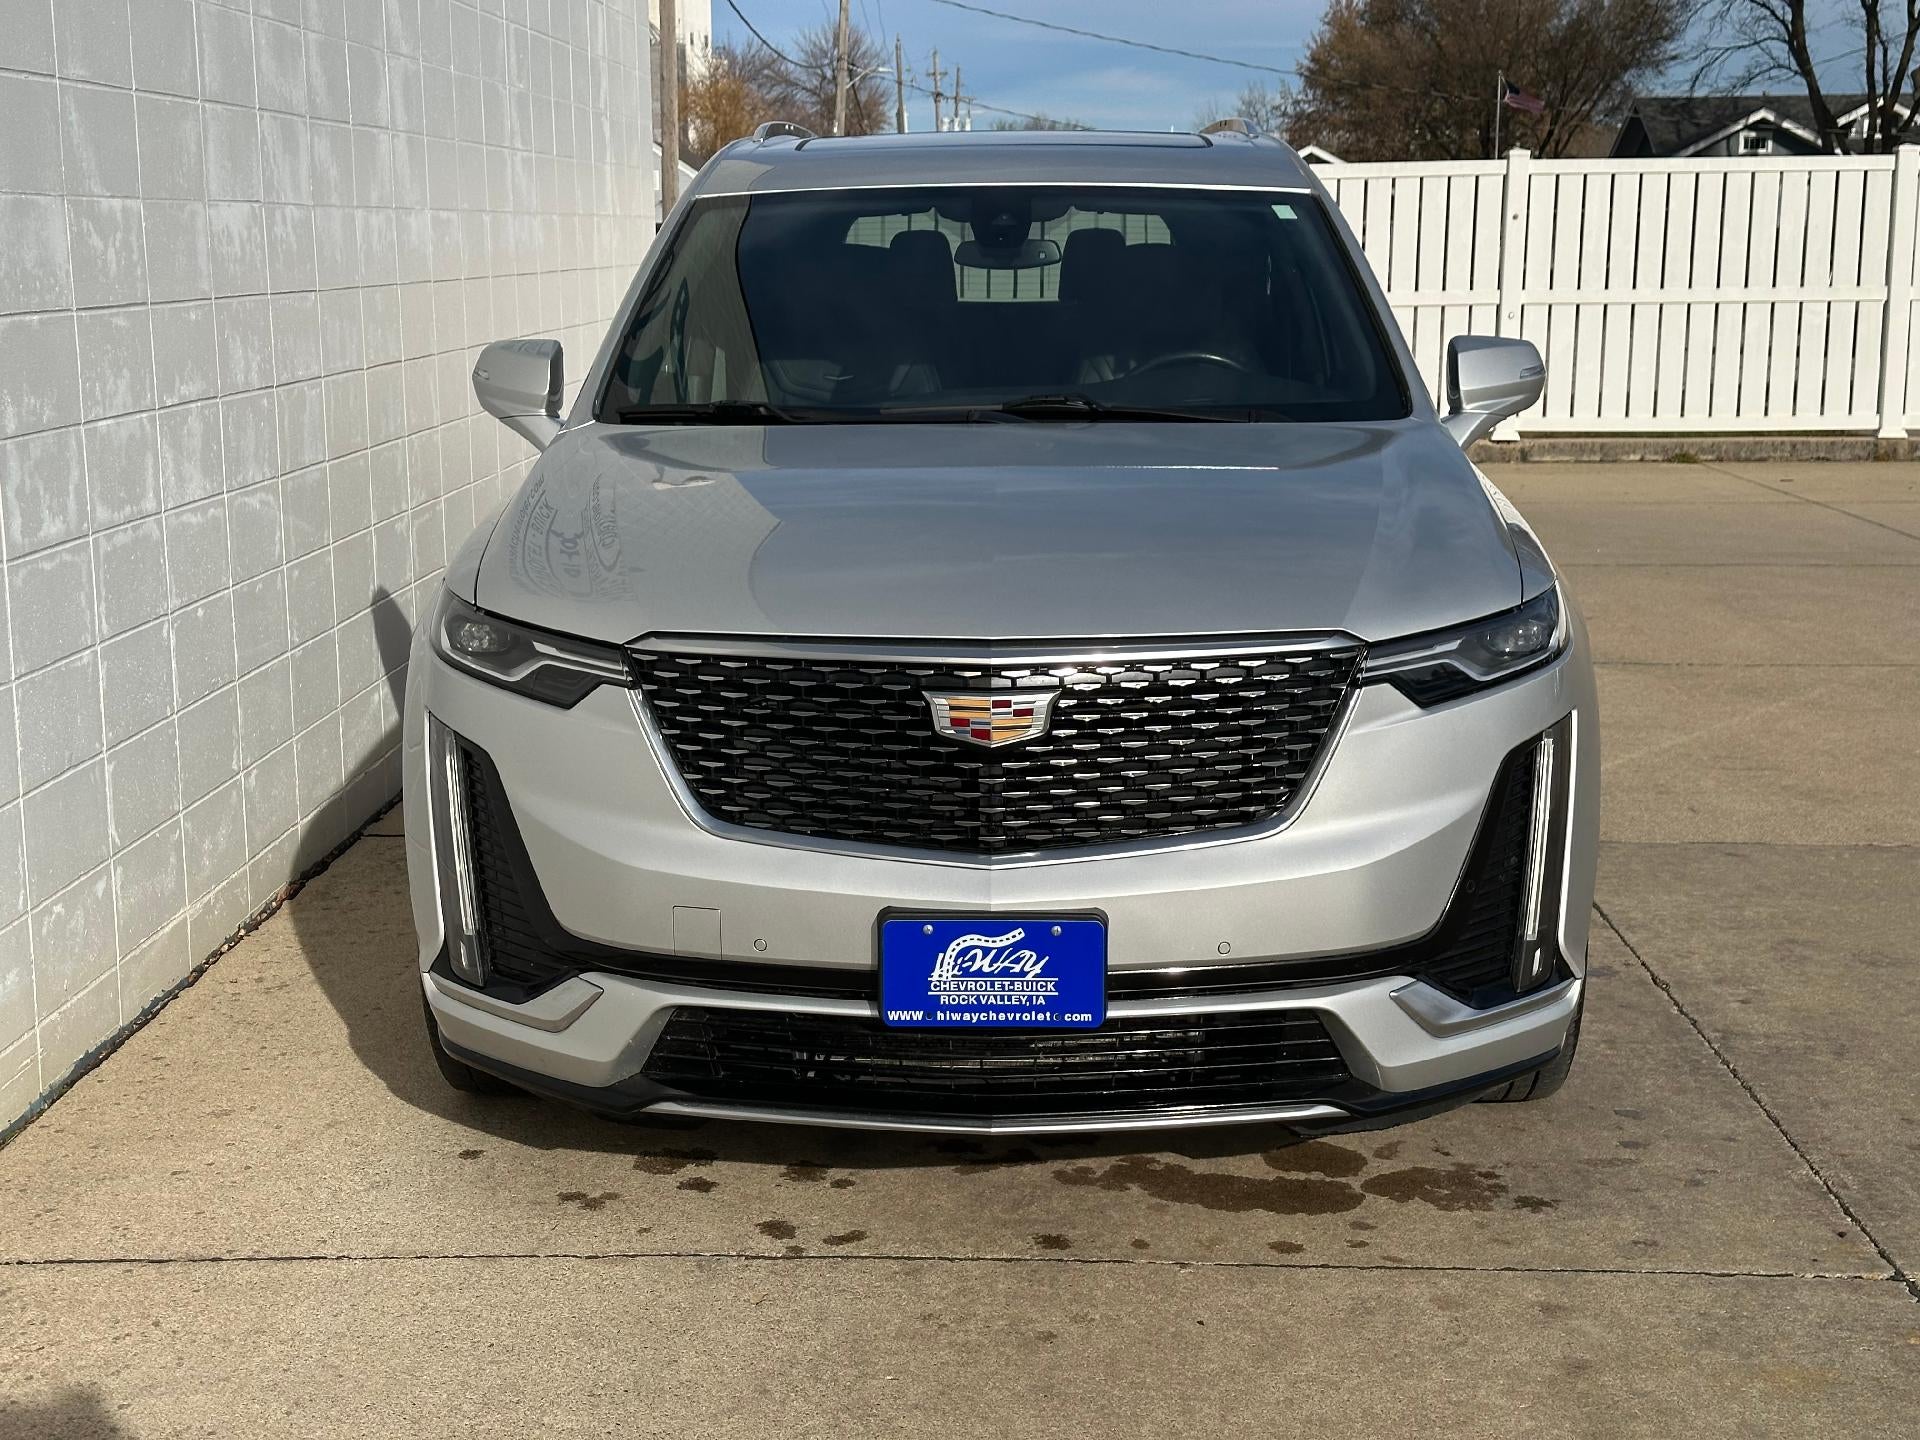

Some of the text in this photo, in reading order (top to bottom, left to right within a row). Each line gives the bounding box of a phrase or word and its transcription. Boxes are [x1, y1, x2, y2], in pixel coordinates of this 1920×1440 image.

[930, 981, 1056, 992] CHEVROLET-BUICK
[940, 996, 1046, 1007] ROCK VALLEY, IA
